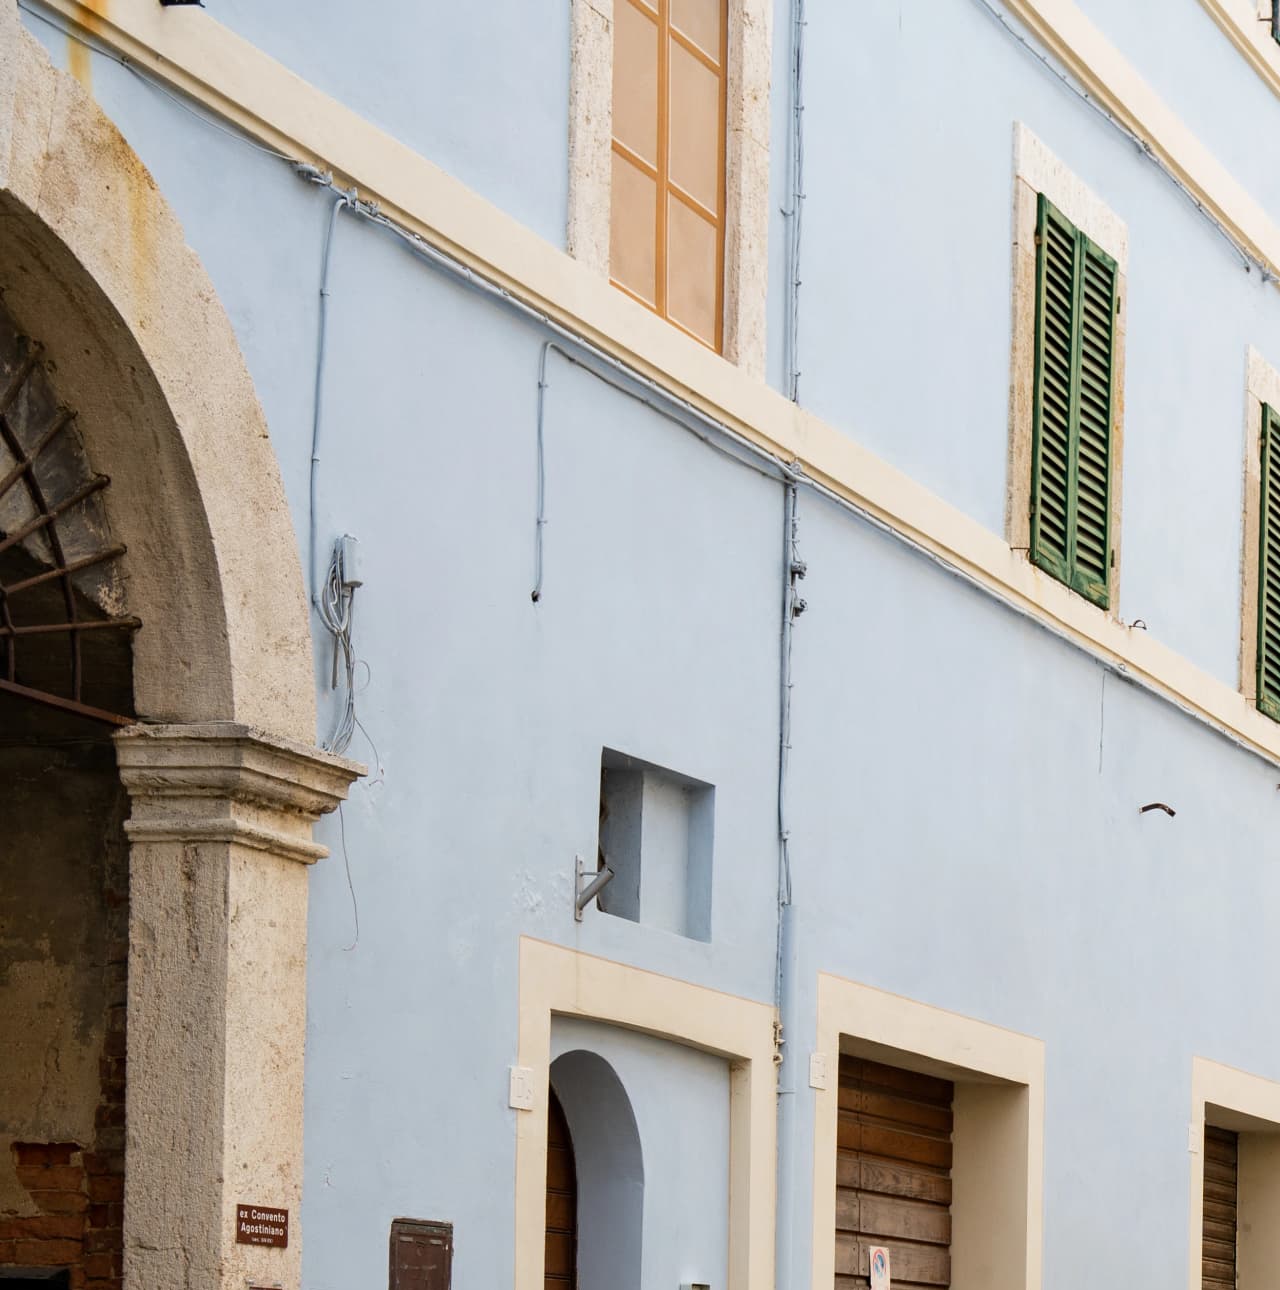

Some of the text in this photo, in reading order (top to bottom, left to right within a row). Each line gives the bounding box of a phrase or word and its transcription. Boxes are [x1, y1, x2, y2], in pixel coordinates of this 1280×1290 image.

[240, 1209, 286, 1223] ex Convento
[241, 1221, 284, 1237] Agostiniano
